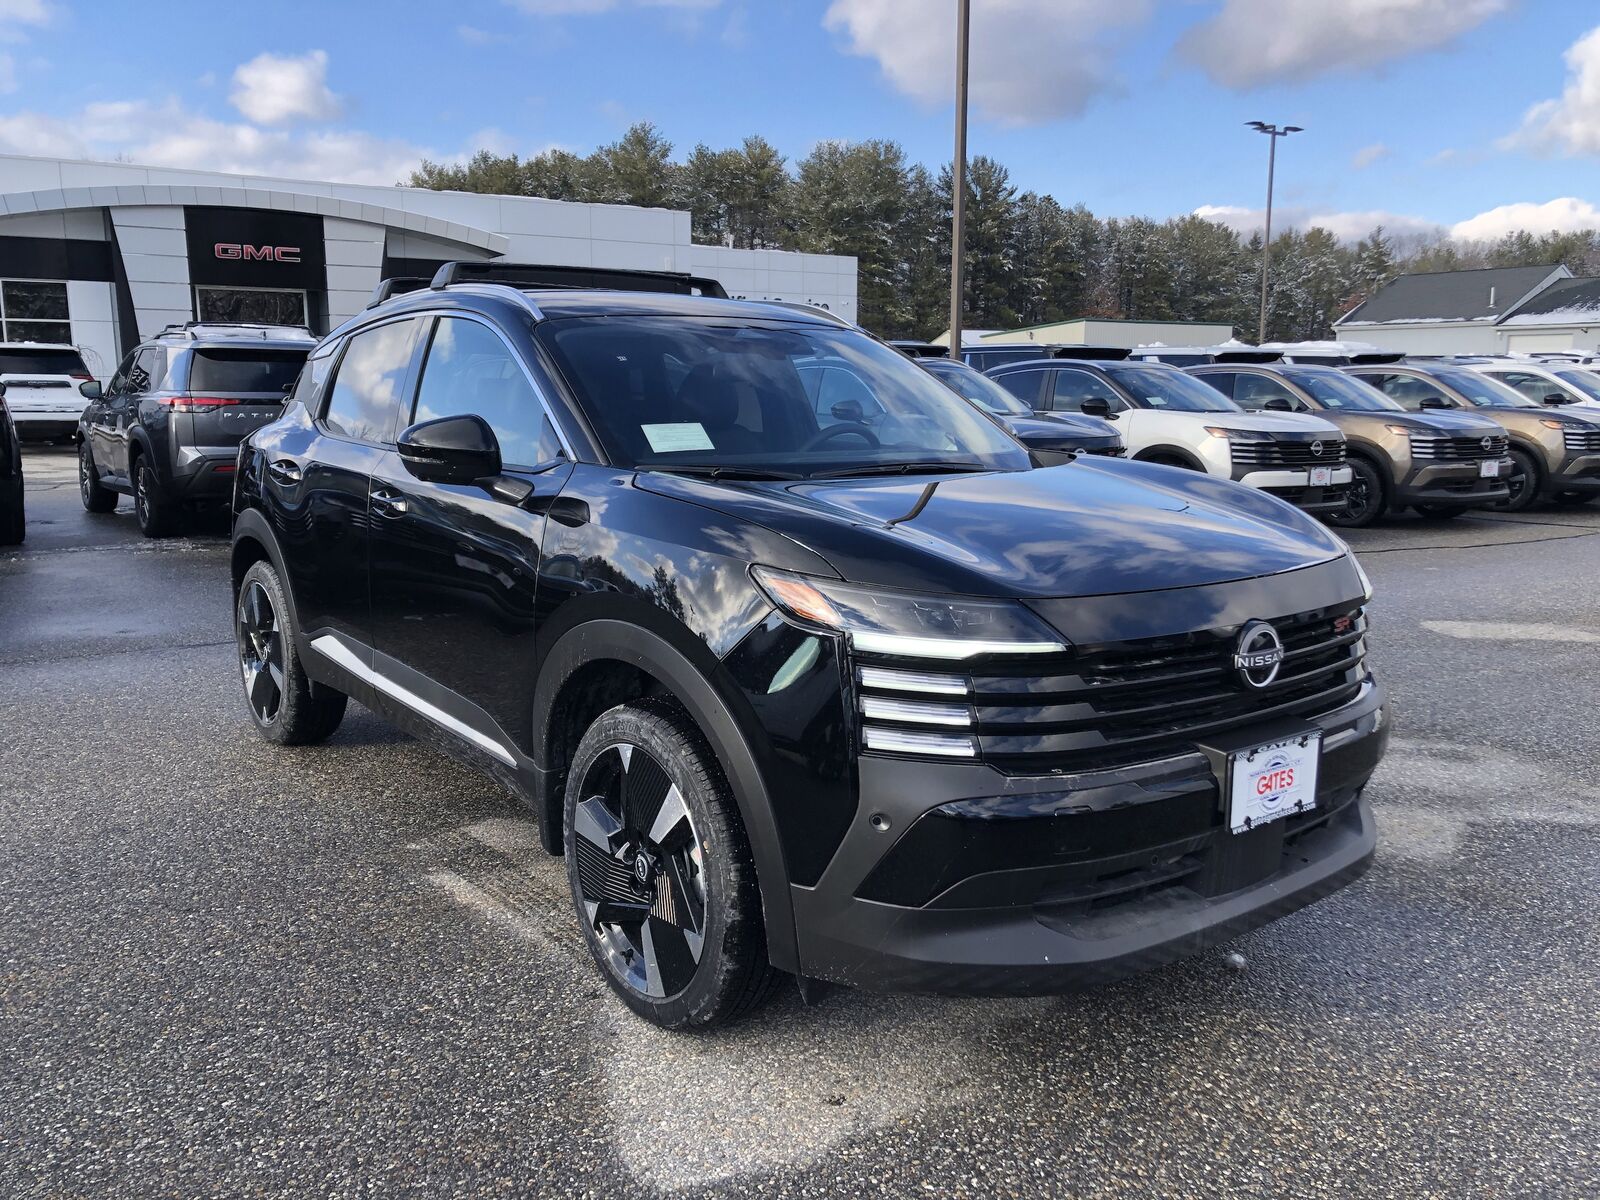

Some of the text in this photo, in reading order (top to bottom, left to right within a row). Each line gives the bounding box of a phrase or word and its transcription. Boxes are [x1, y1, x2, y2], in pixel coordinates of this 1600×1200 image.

[214, 243, 300, 262] GMC
[1238, 650, 1284, 668] NISSAN
[1257, 768, 1294, 795] GATES
